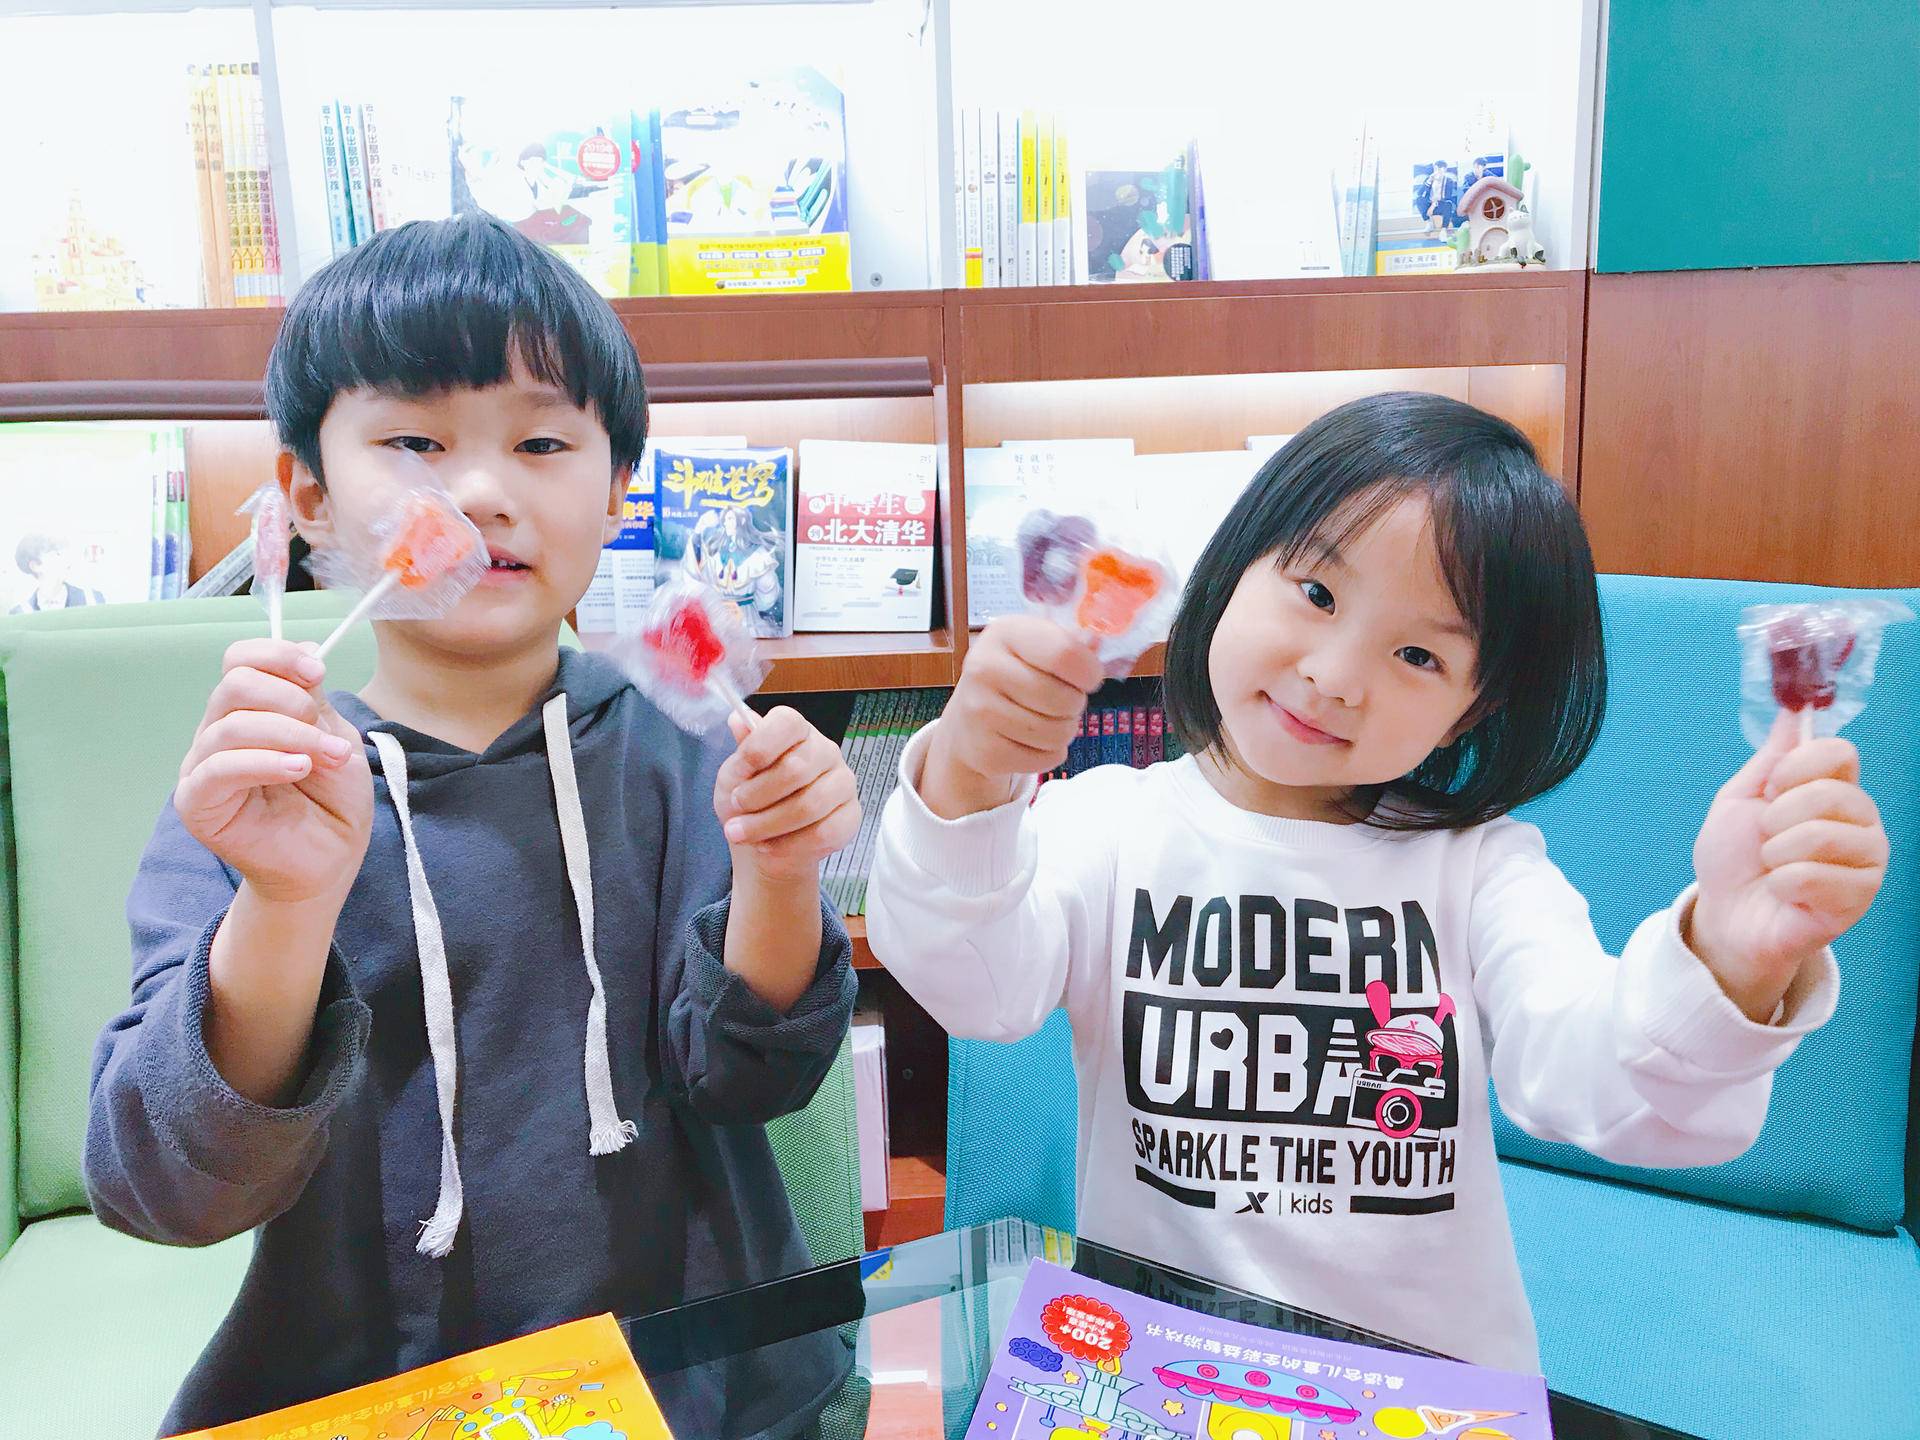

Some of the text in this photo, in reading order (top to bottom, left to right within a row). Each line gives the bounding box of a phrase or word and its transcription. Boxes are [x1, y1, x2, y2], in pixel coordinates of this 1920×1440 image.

[662, 458, 778, 510] 斗破苍穹
[807, 518, 927, 545] 到北大清华
[1125, 888, 1442, 995] MODERN
[1132, 1117, 1456, 1188] SPARKLE THE YOUTH
[1291, 1192, 1333, 1214] kids
[1059, 1325, 1113, 1351] 200+
[1145, 1322, 1405, 1390] 最适合儿童的全彩益智游戏书
